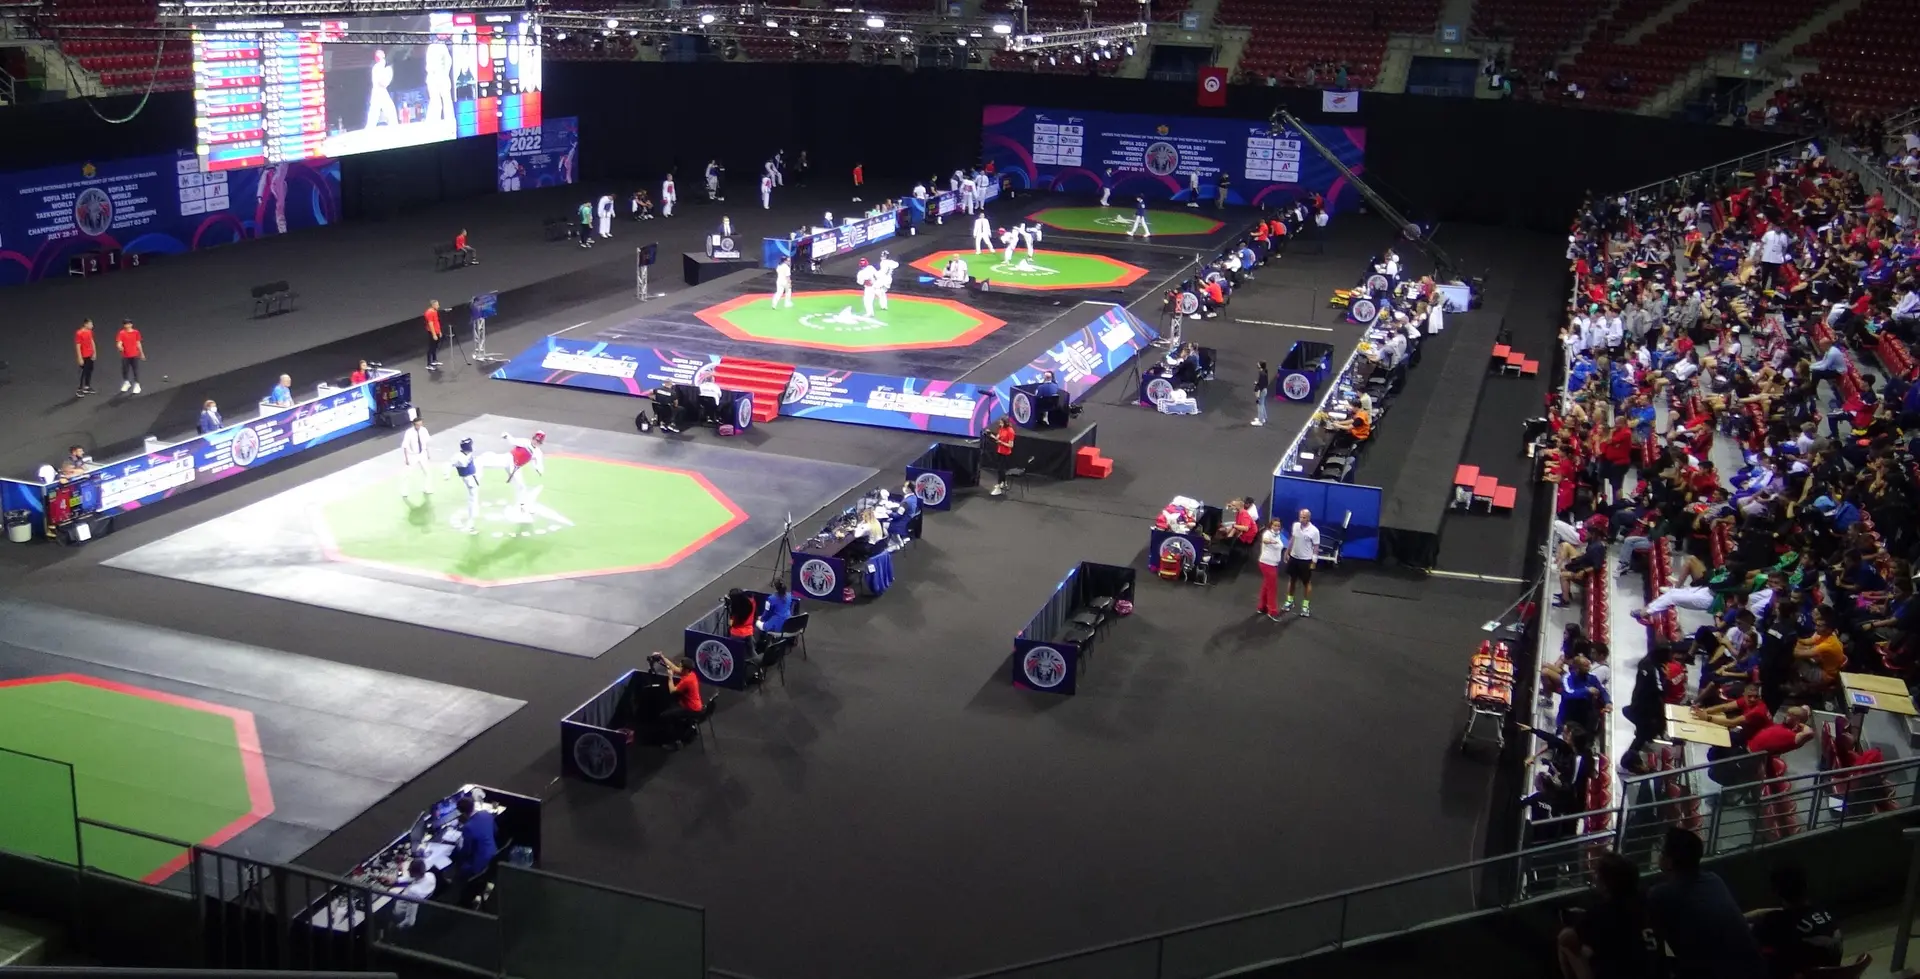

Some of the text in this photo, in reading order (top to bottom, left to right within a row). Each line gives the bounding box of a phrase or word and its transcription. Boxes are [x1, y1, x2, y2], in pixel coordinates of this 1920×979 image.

[510, 135, 542, 152] 2022
[43, 194, 61, 203] SOFIA
[111, 192, 131, 200] WORLD
[52, 201, 73, 209] WORLD
[109, 253, 115, 264] 1
[133, 254, 139, 266] 3
[90, 260, 97, 271] 2
[60, 499, 67, 509] 4
